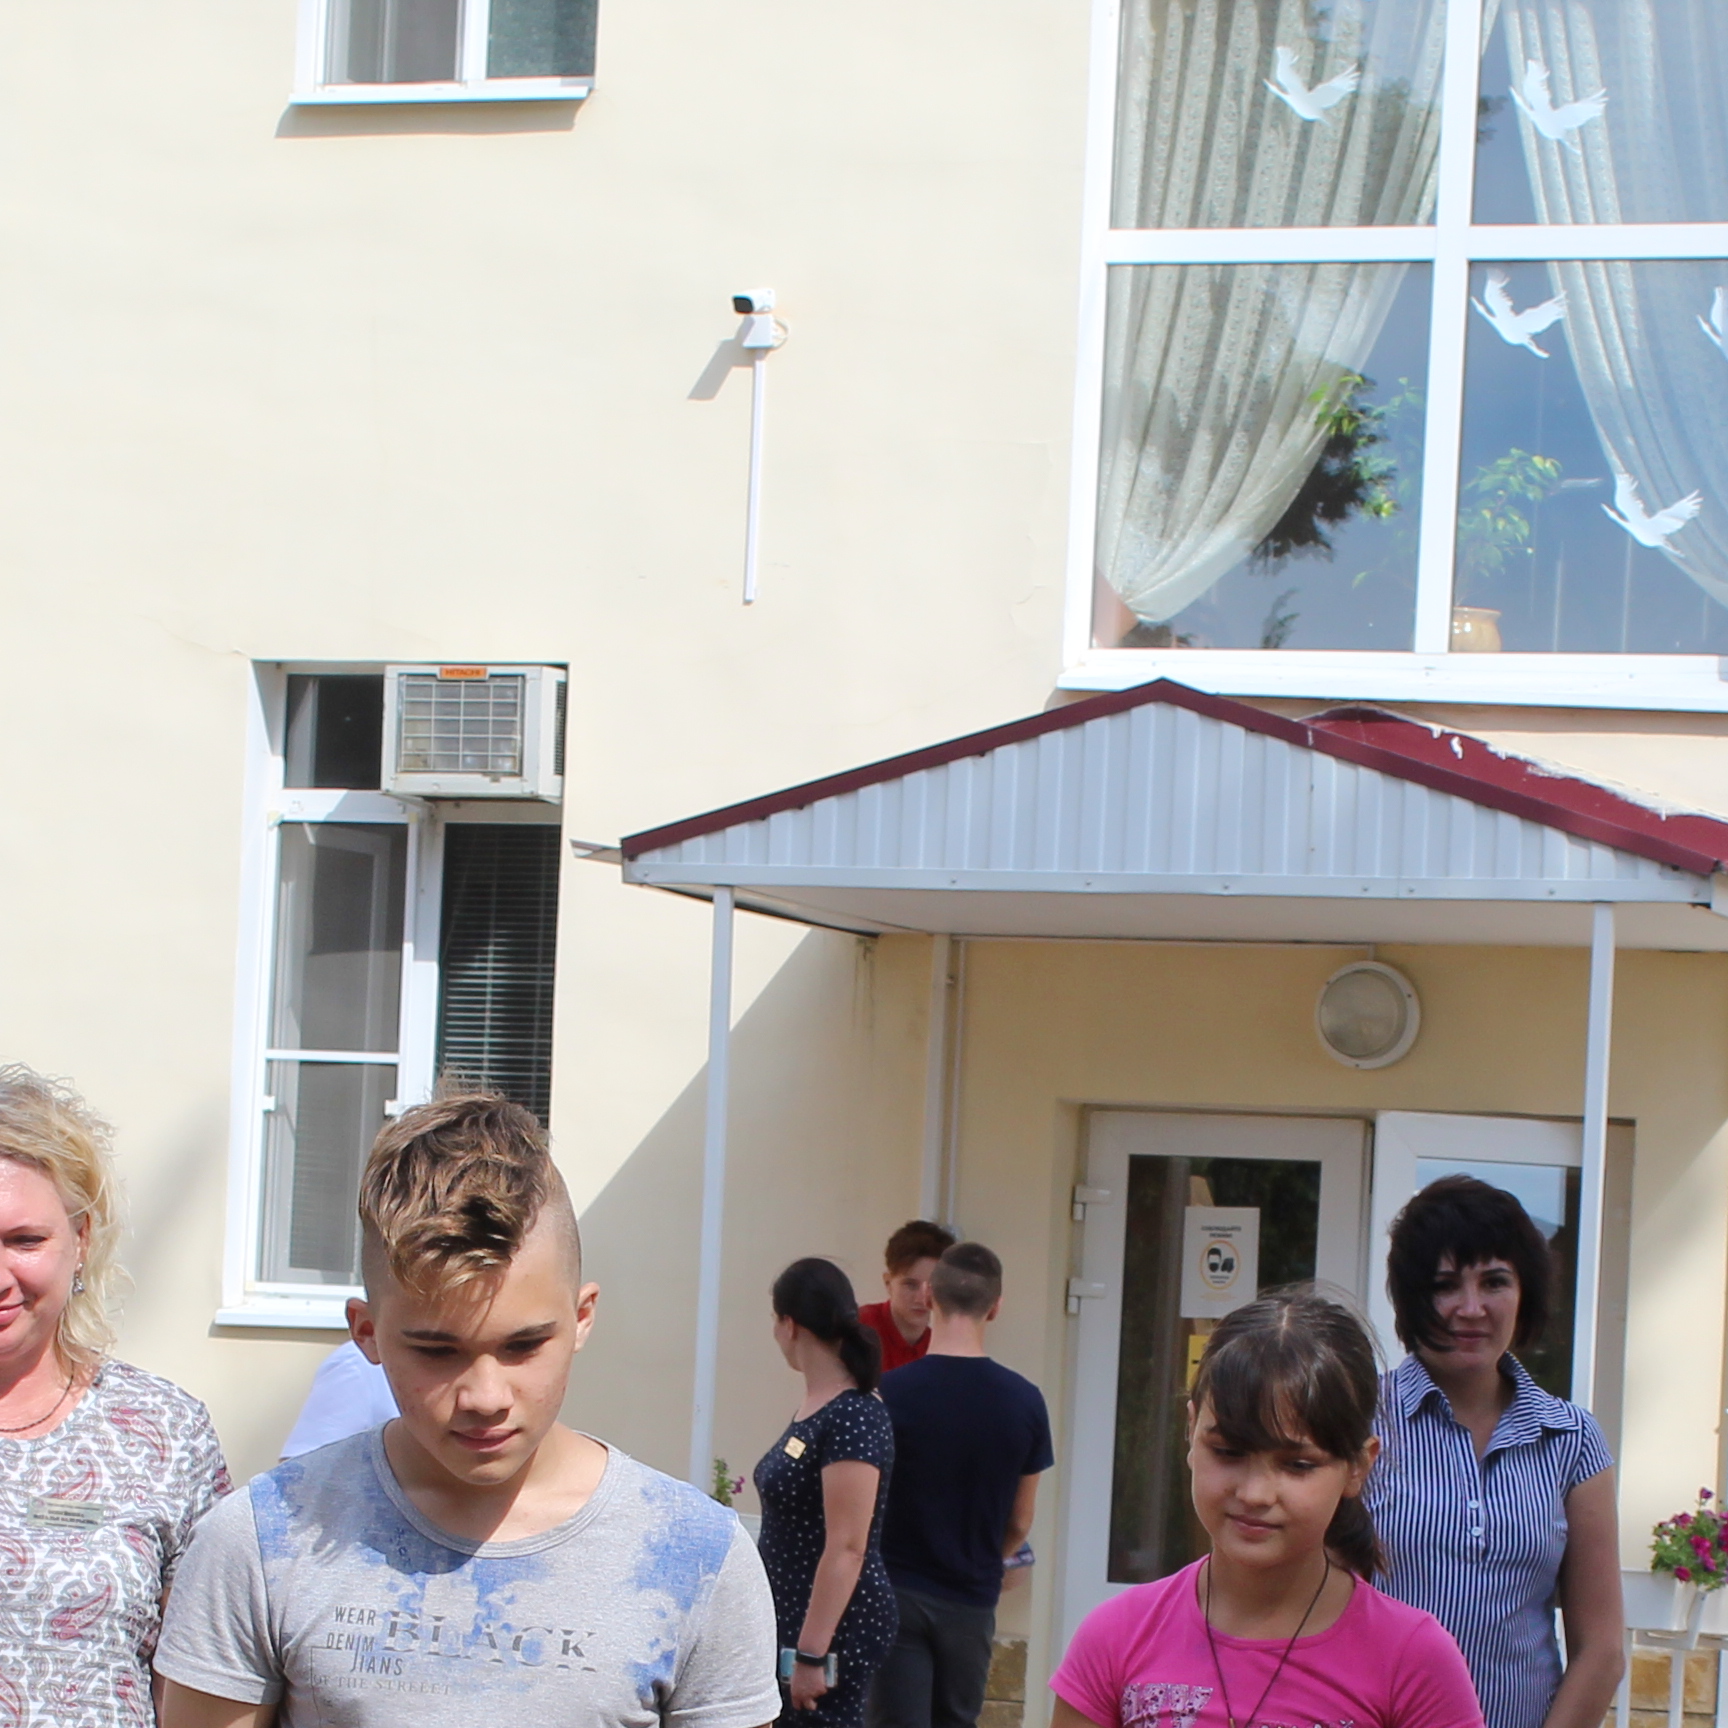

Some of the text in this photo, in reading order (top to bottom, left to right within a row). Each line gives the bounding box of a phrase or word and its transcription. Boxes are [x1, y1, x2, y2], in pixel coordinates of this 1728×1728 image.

[334, 1605, 377, 1627] WEAR
[326, 1632, 374, 1653] DENIM
[383, 1610, 597, 1673] BLACK
[337, 1674, 369, 1690] THE
